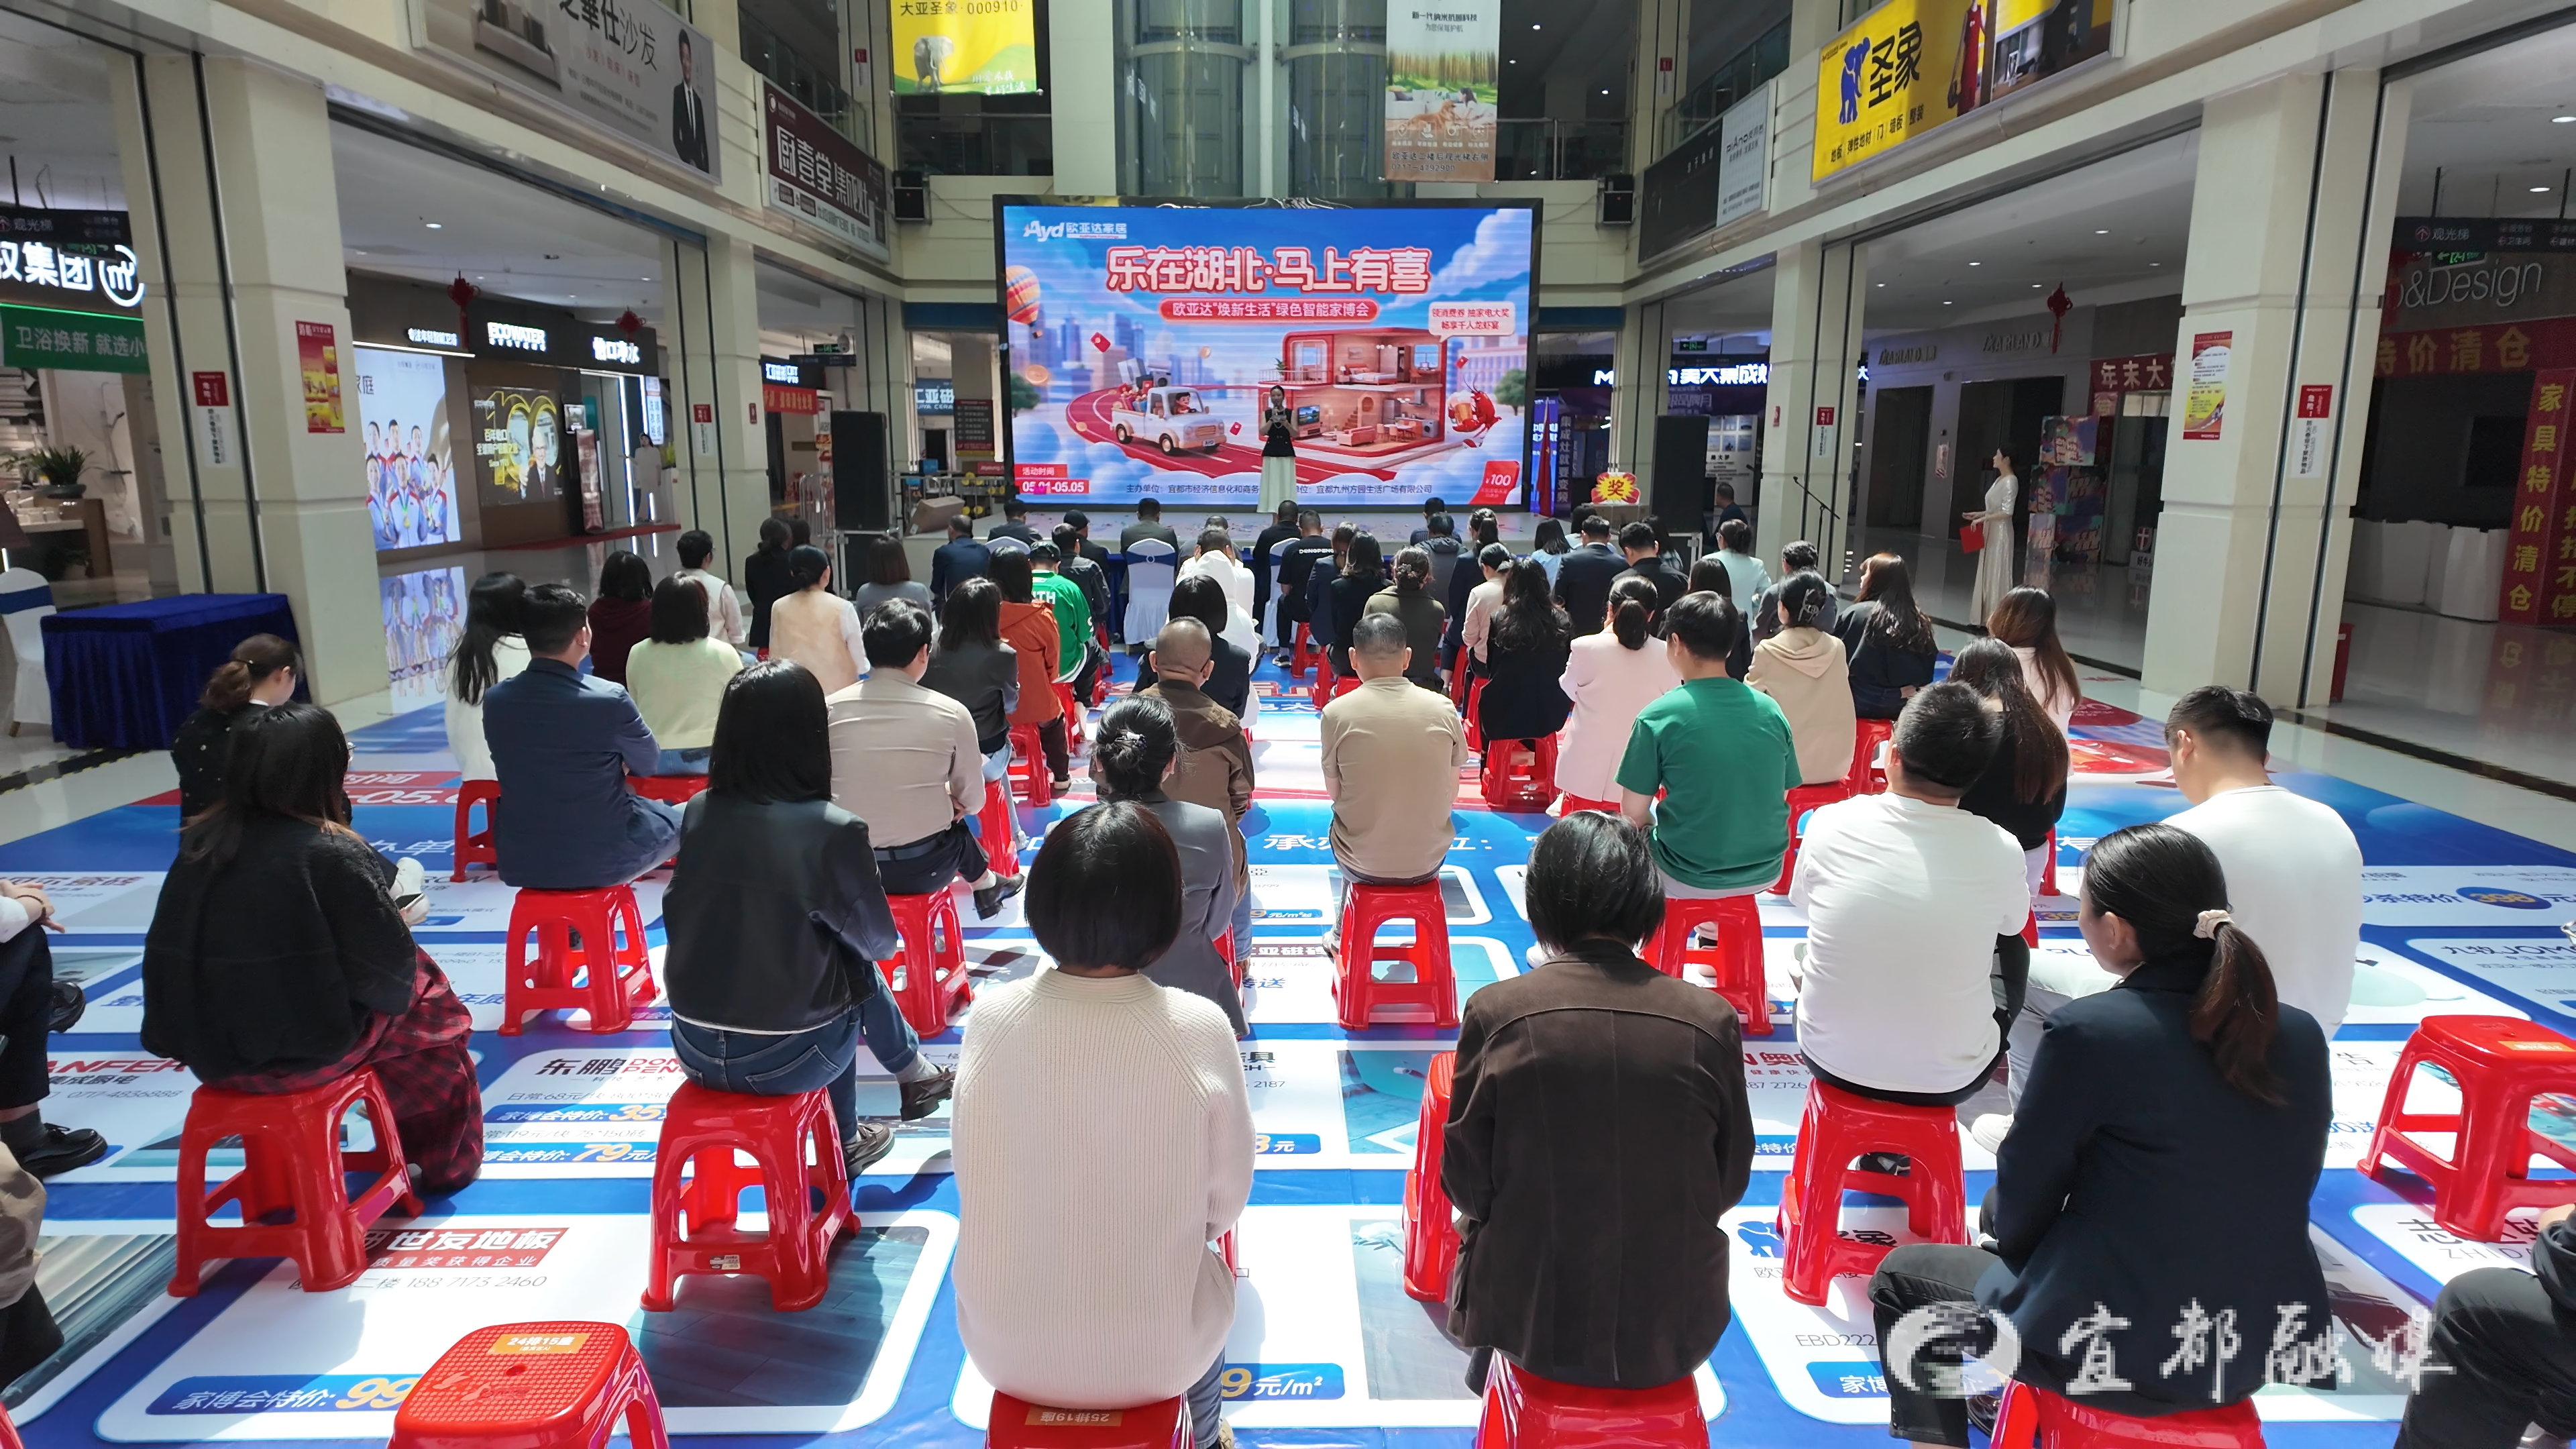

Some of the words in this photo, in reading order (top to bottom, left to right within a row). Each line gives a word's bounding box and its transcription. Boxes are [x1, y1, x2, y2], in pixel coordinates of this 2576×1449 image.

[900, 2, 958, 15] 大亚圣象
[967, 1, 1018, 15] 000910
[1868, 20, 1922, 109] 圣象
[1831, 144, 1843, 162] 地板
[1876, 123, 1884, 141] 门
[1023, 220, 1065, 242] Ayd
[1066, 222, 1127, 234] 欧亚达家居
[2431, 227, 2470, 241] 观光梯
[2397, 256, 2542, 309] &Design
[15, 325, 90, 355] 卫浴换新
[2100, 358, 2176, 390] 年末大
[1557, 415, 1572, 502] 集成灶就要变频
[1022, 468, 1055, 476] 活动时间
[1168, 484, 1259, 494] 宜都市经济信息化和商务
[1316, 484, 1432, 494] 宜都九州方园生活广场有限公司
[1607, 479, 1624, 497] 奖
[2509, 383, 2565, 611] 家具特价清仓
[2469, 893, 2536, 904] 398
[535, 1058, 628, 1075] 东鹏
[608, 1104, 663, 1122] 35
[572, 1143, 633, 1162] 79
[1273, 1140, 1295, 1152] 元
[386, 1230, 561, 1251] 世友地板
[372, 1255, 537, 1267] 质量奖获得企业
[407, 1277, 443, 1288] 188
[447, 1277, 490, 1287] 7173
[494, 1276, 547, 1287] 2460
[506, 1336, 576, 1346] 24排15座
[1256, 1375, 1324, 1397] 元/m²
[172, 1389, 337, 1410] 家博会特价：
[1040, 1411, 1110, 1424] 25排19座
